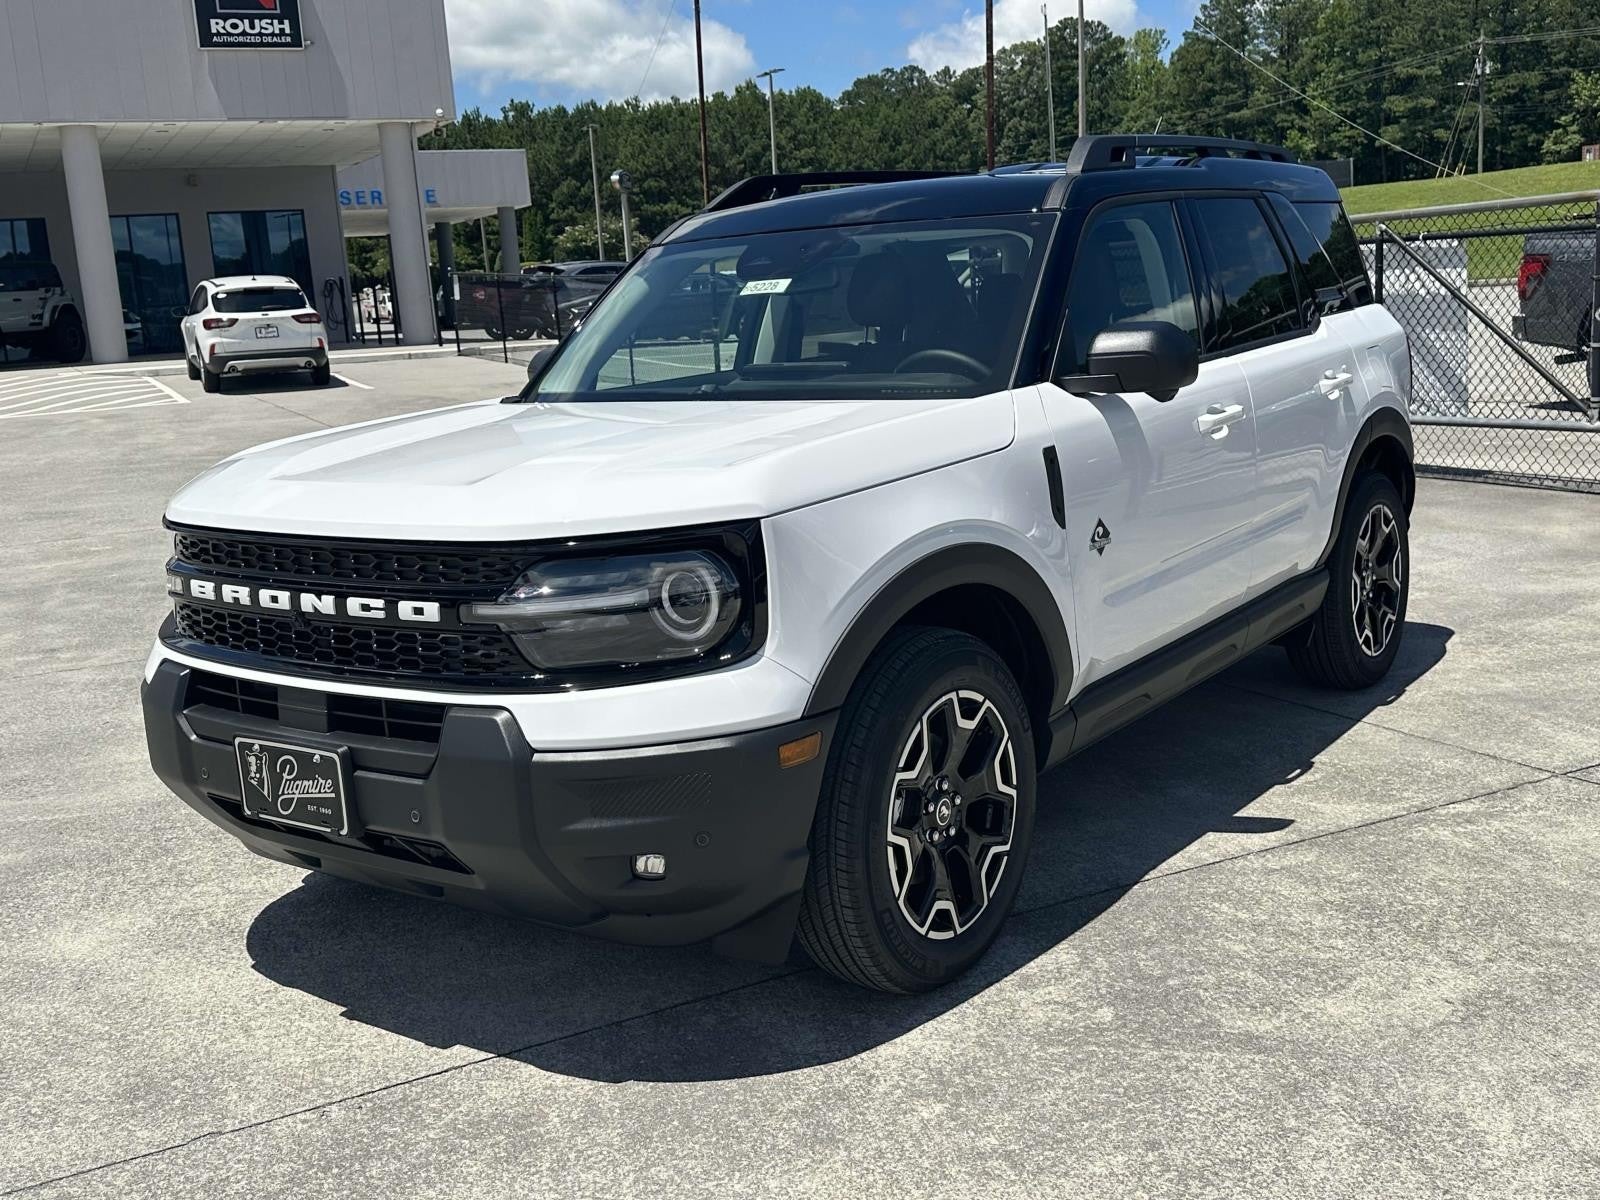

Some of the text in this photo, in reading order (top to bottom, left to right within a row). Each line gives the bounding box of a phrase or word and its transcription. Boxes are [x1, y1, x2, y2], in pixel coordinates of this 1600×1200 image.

[209, 18, 290, 34] ROUSH
[212, 35, 291, 43] AUTHORIZED DEALER
[340, 187, 438, 206] SERE
[190, 579, 440, 622] BRONCO
[277, 754, 336, 815] Pugmire
